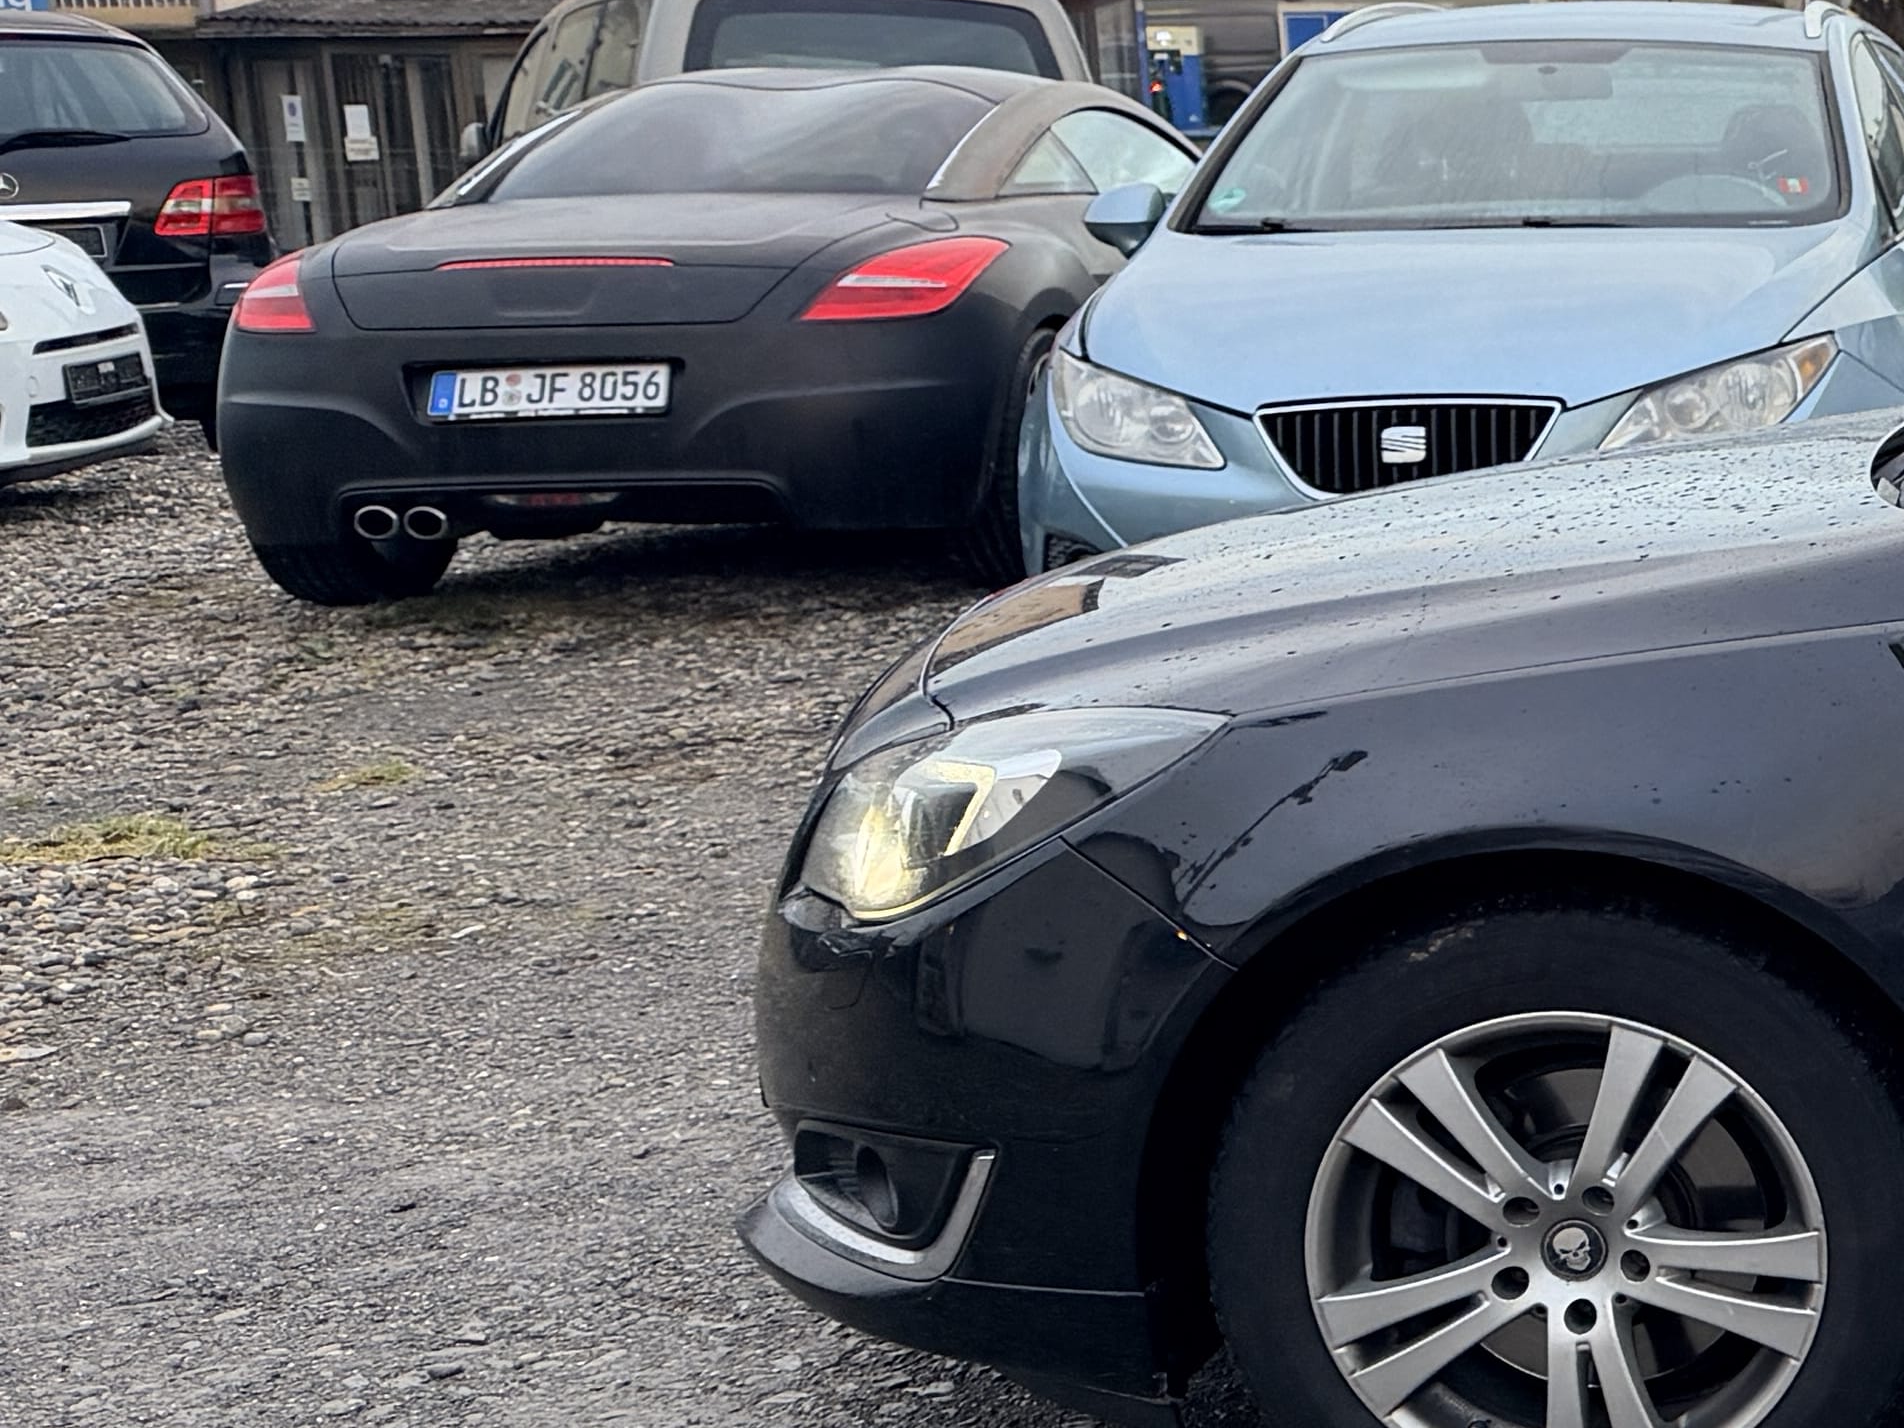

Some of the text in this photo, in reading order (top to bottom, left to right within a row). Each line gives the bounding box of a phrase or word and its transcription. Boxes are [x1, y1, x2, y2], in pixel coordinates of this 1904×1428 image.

[457, 370, 660, 408] LB JF 8056
